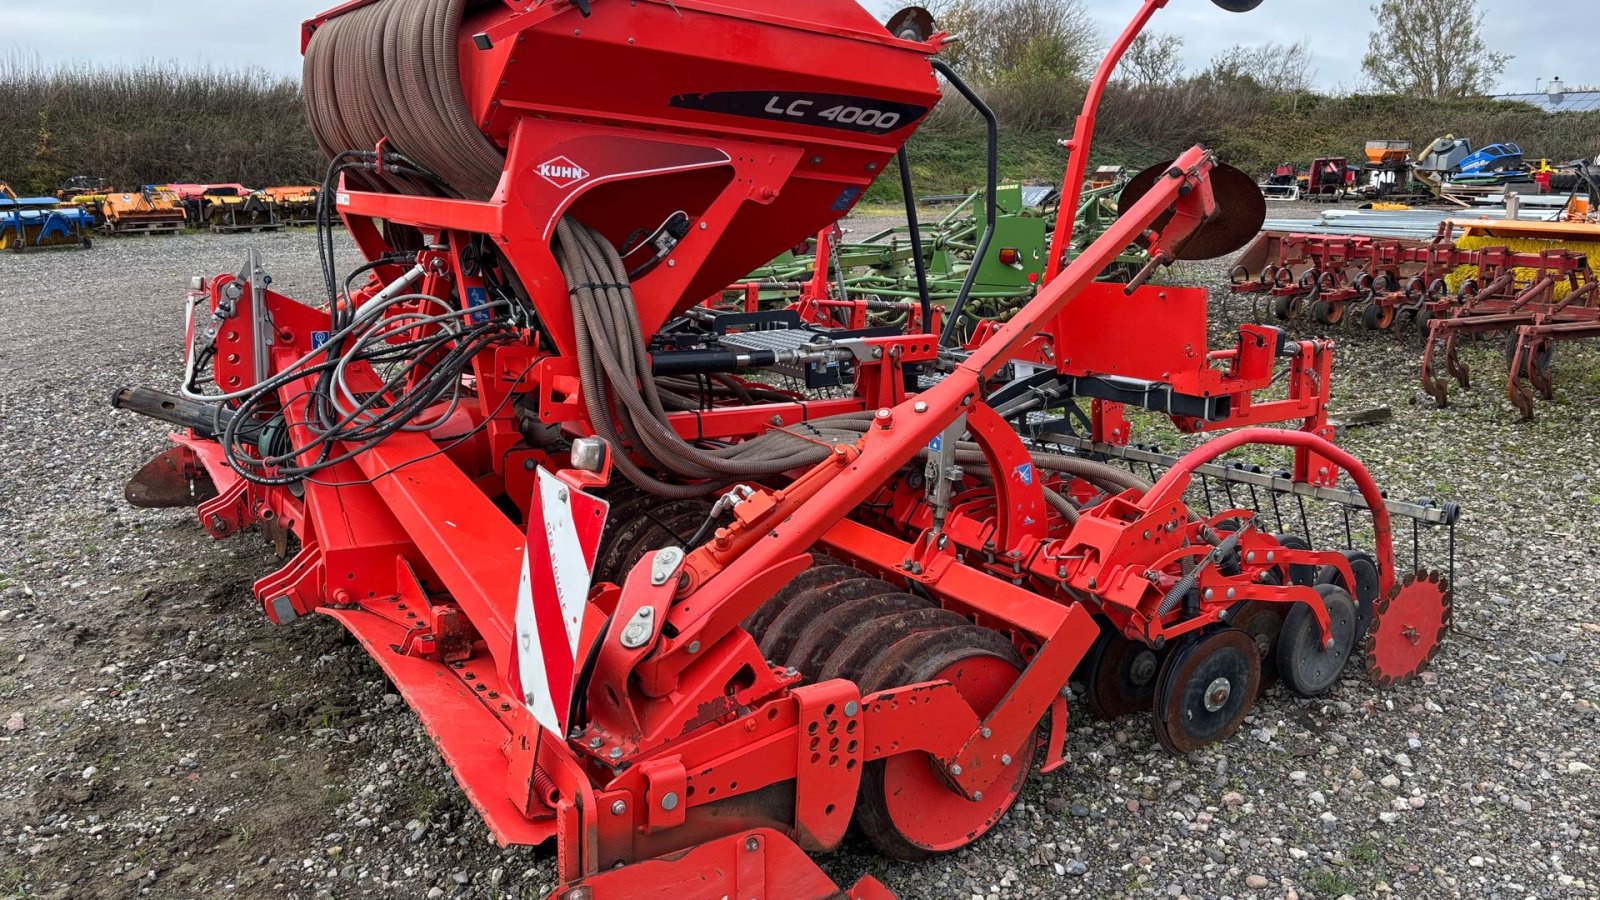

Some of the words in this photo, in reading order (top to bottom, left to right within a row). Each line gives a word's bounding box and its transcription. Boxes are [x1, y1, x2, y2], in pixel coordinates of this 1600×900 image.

[764, 96, 813, 117] LC
[818, 105, 901, 129] 4000
[541, 164, 582, 179] KUHN
